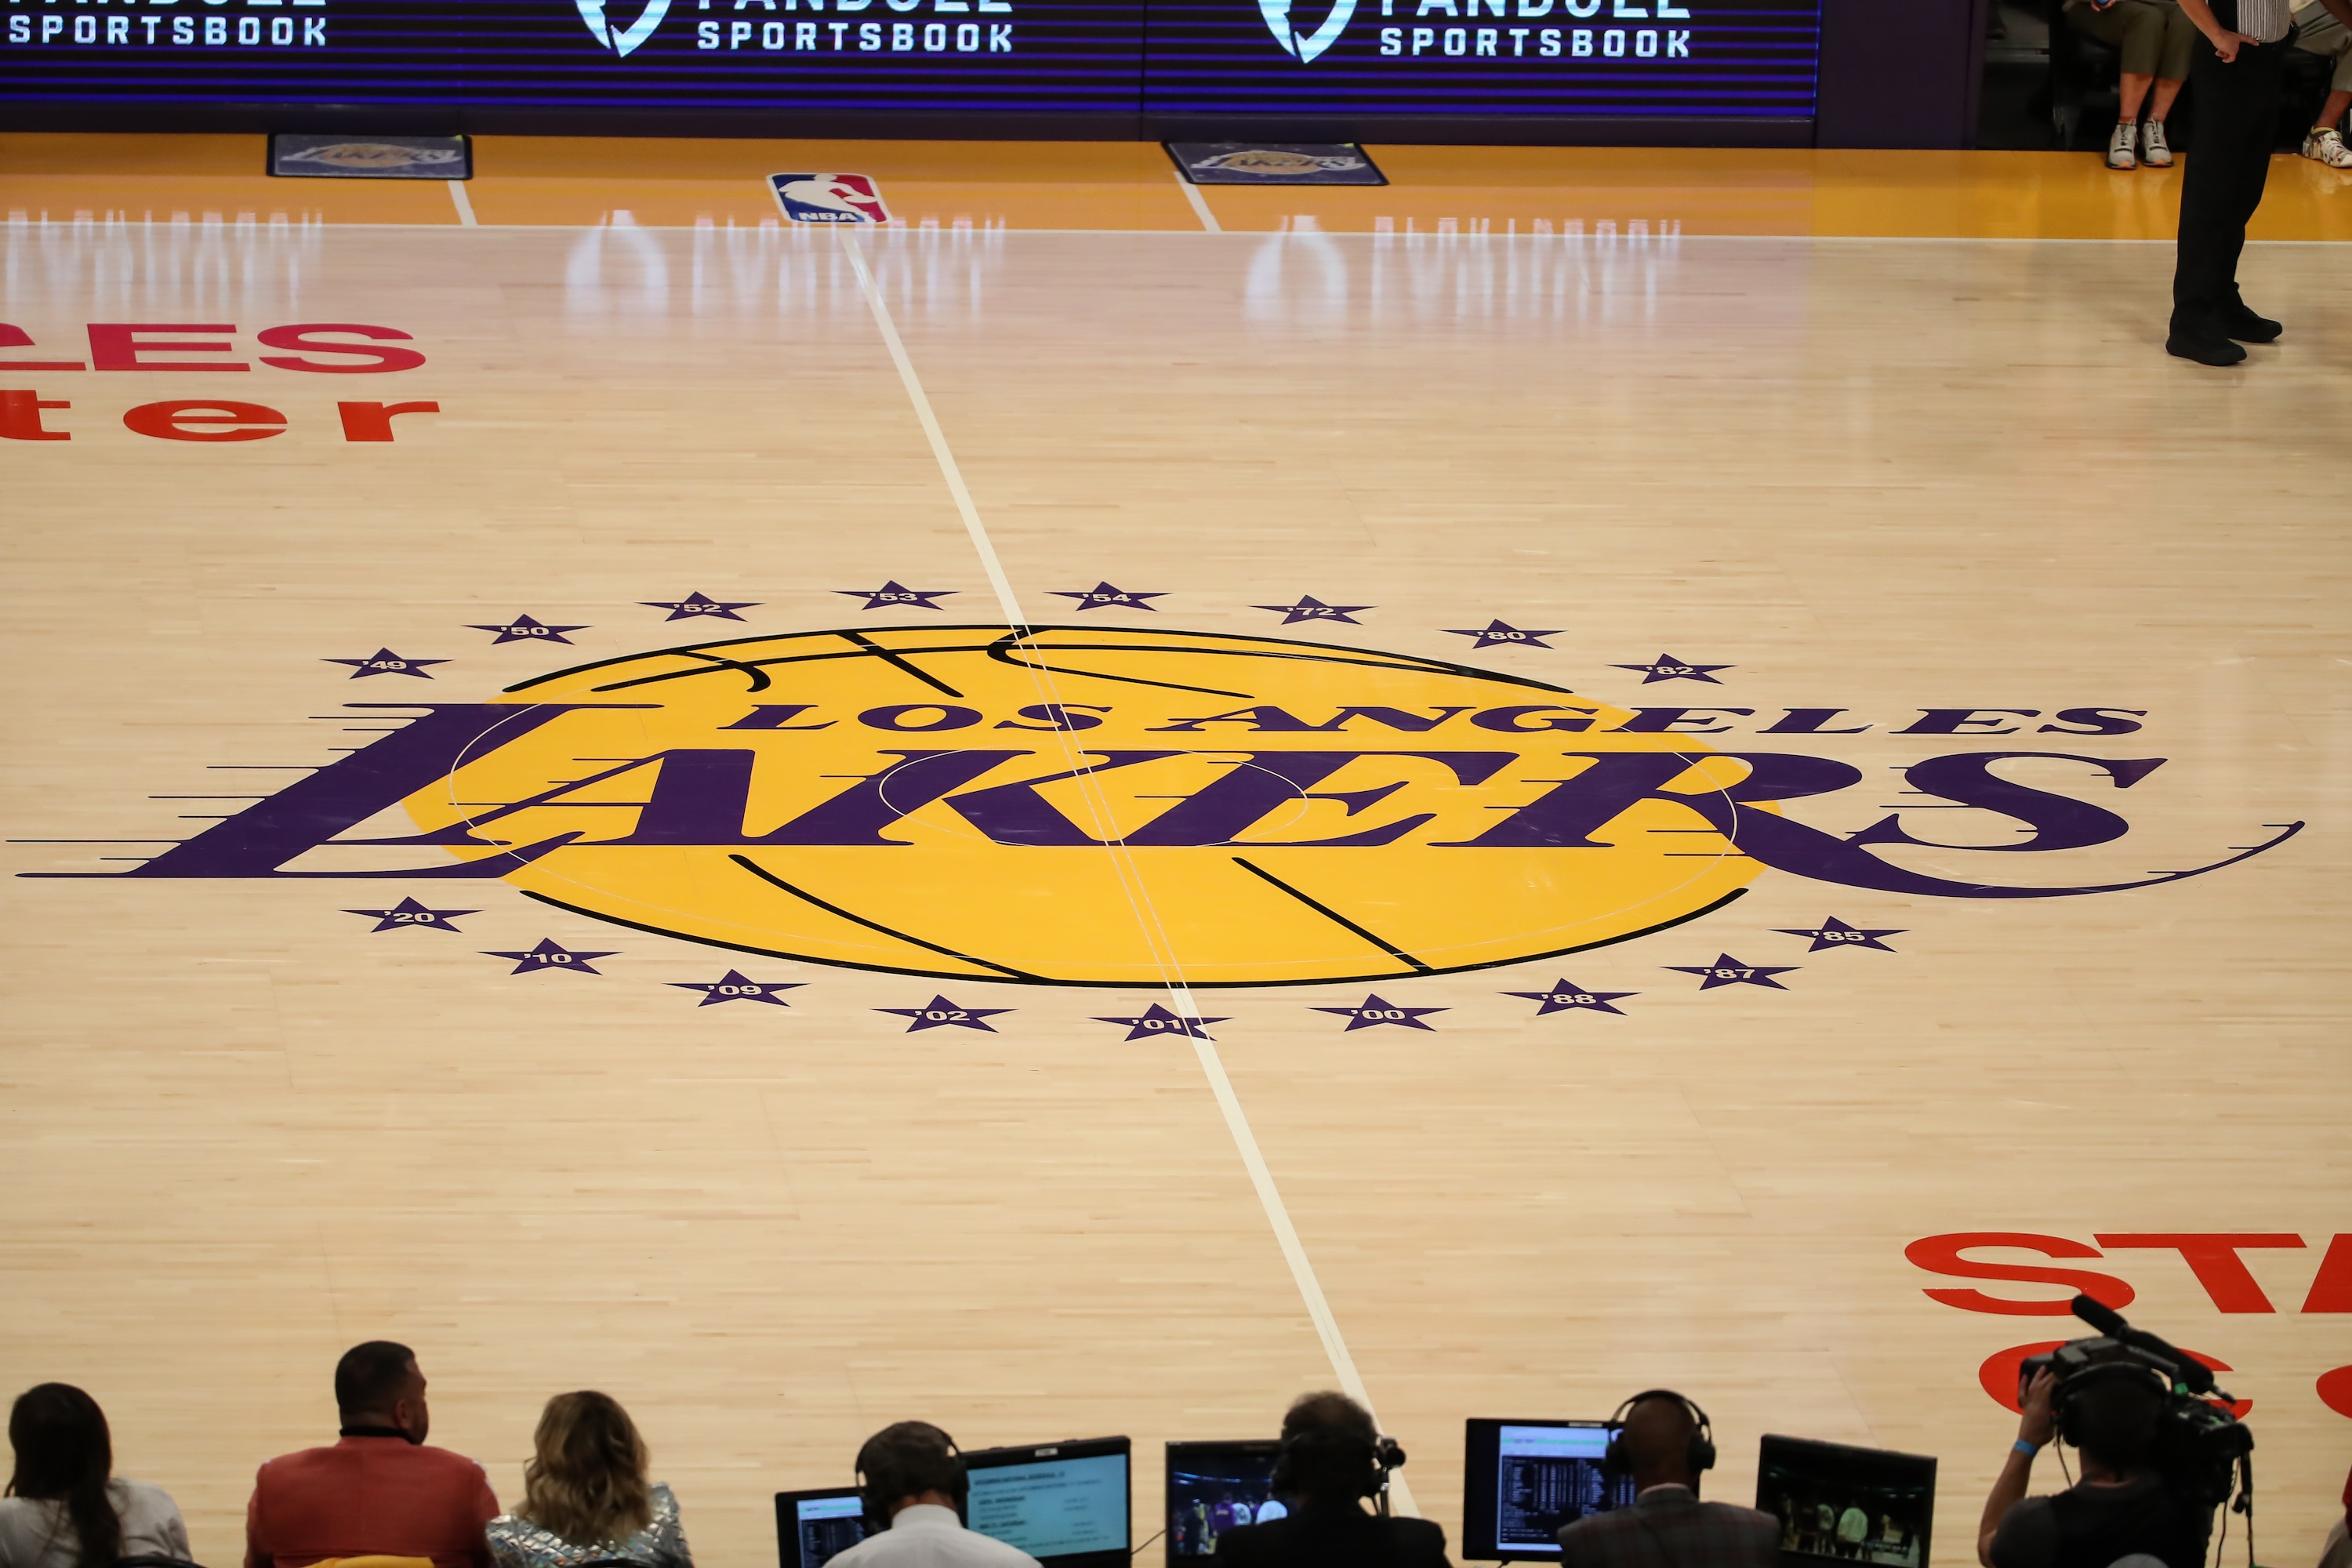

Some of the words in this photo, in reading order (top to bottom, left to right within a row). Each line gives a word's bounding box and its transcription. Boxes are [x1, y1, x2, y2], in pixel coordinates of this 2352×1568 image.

[9, 15, 325, 45] SPORTSBOOK
[697, 21, 1012, 52] SPORTSBOOK
[1380, 27, 1690, 58] SPORTSBOOK
[798, 212, 858, 221] NBA
[720, 705, 1111, 731] LOS
[1145, 706, 2147, 735] ANGELES
[16, 703, 2303, 898] LAKERS
[1904, 1232, 2352, 1316] ST
